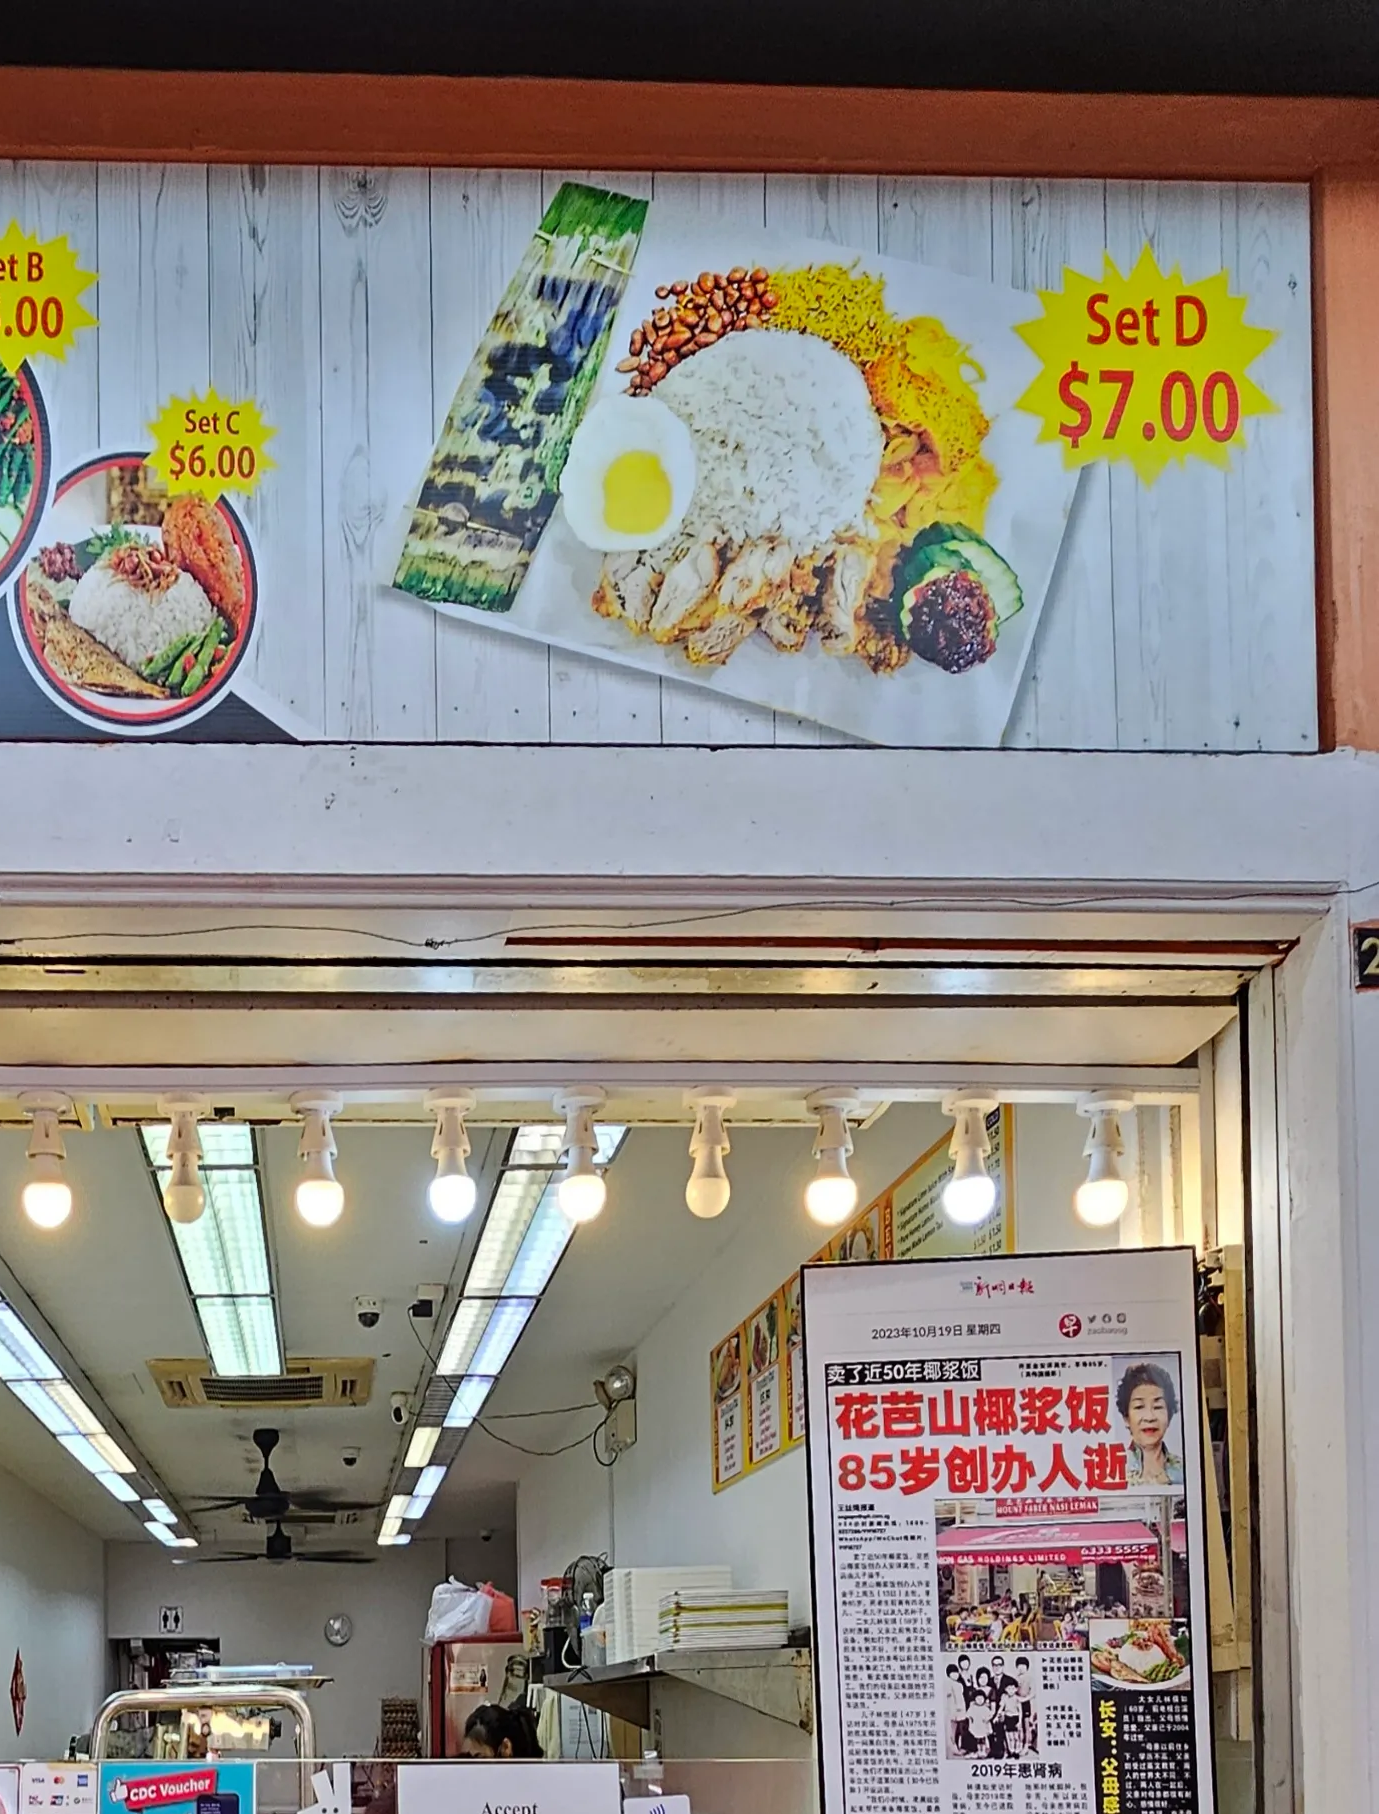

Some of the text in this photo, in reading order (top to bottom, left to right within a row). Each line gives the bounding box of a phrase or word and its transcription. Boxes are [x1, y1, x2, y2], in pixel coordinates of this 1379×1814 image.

[27, 251, 44, 282] B
[1086, 293, 1207, 346] Set D
[1058, 366, 1240, 449] $7.00
[185, 410, 241, 435] Set C
[169, 442, 255, 480] $6.00
[871, 1323, 1001, 1340] 2023年10月19日 星期四
[1061, 1314, 1081, 1337] 早
[827, 1360, 979, 1384] 卖了近50年椰浆饭
[835, 1385, 1111, 1440] 花芭山椰浆饭
[838, 1441, 1129, 1496] 85岁创办人逝
[1050, 1502, 1069, 1512] NASI
[957, 1555, 975, 1564] GAS
[1028, 1553, 1067, 1562] LIMITED
[1080, 1544, 1149, 1555] 6333 5555
[971, 1762, 1063, 1779] 2019年患肾病
[130, 1777, 211, 1802] CDC Voucher
